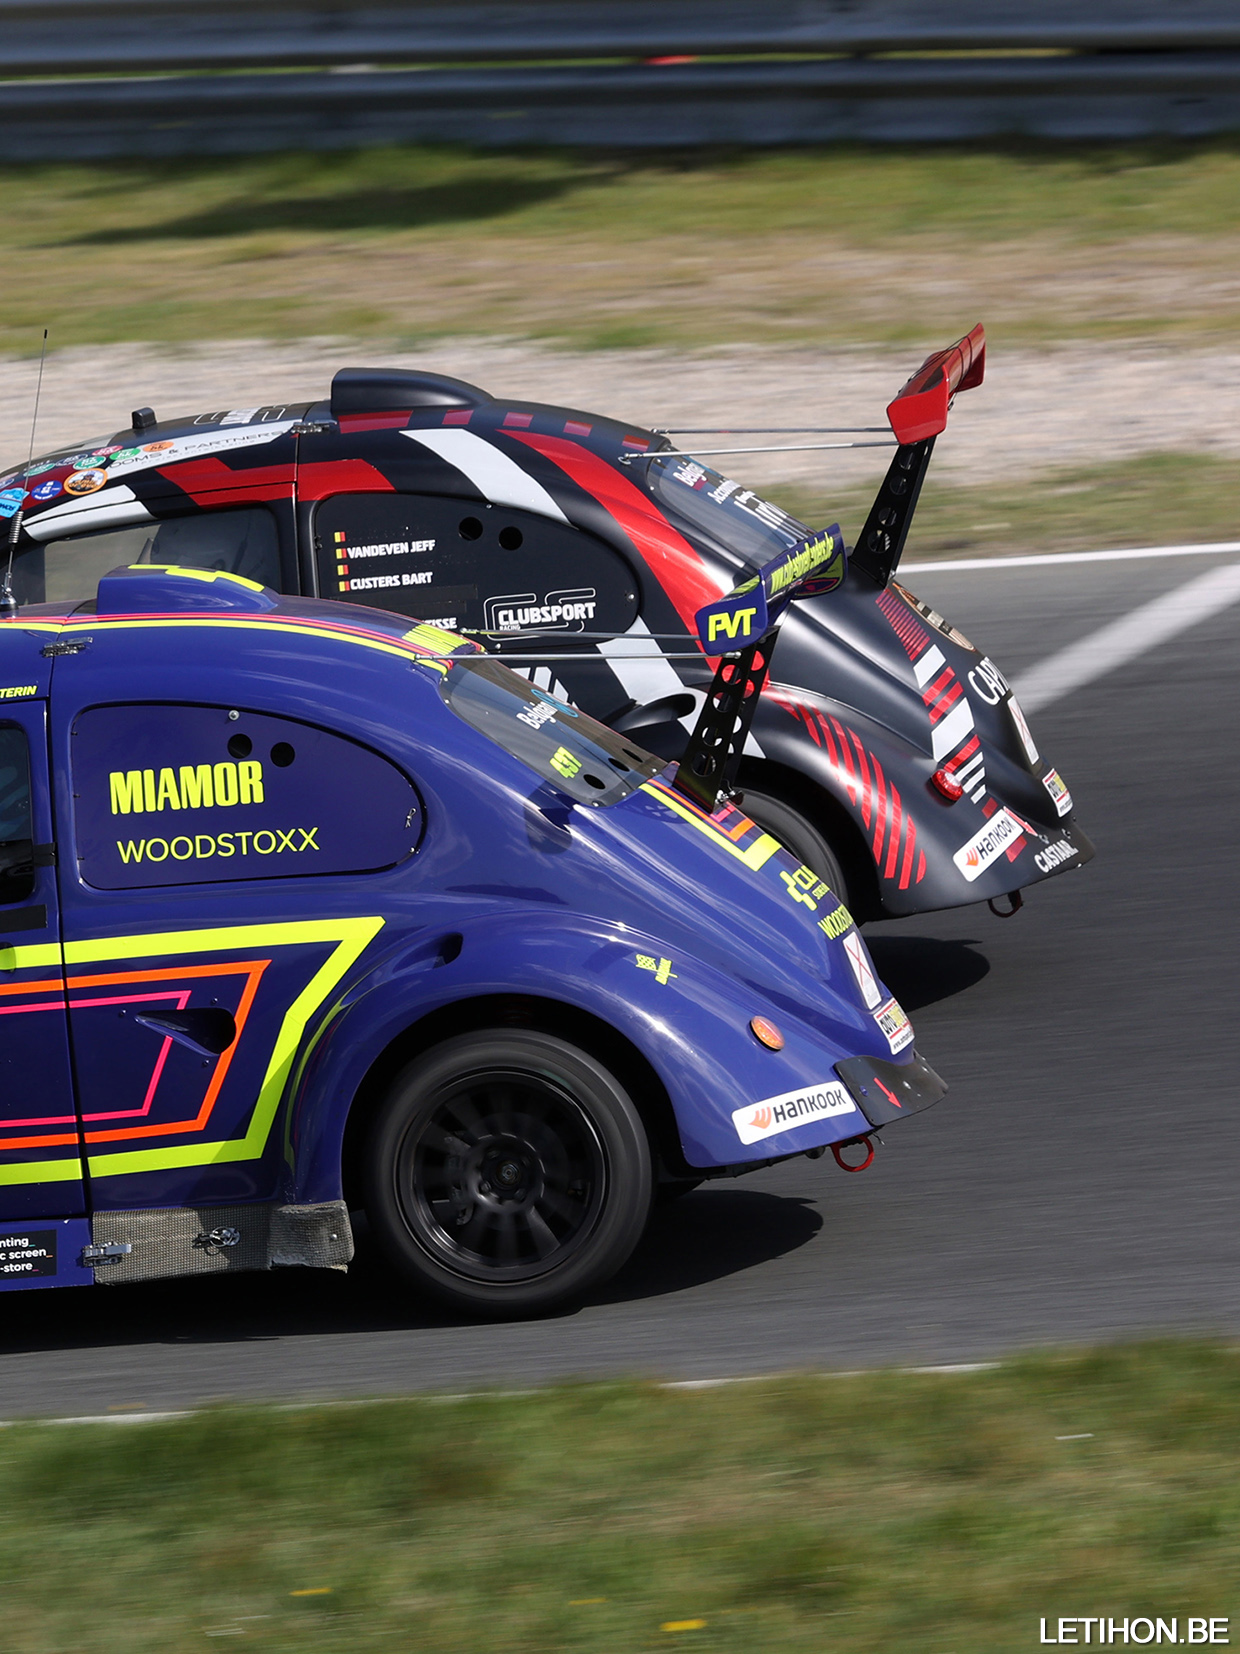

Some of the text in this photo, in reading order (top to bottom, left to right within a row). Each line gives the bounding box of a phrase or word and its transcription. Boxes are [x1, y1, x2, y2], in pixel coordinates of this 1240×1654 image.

[347, 540, 436, 559] VANDEVEN JEFF
[350, 571, 433, 590] CUSTERS BART
[498, 601, 597, 626] CLUBSPORT
[708, 607, 757, 642] PVT
[109, 760, 265, 815] MIAMOR
[116, 826, 320, 864] WOODSTOXX
